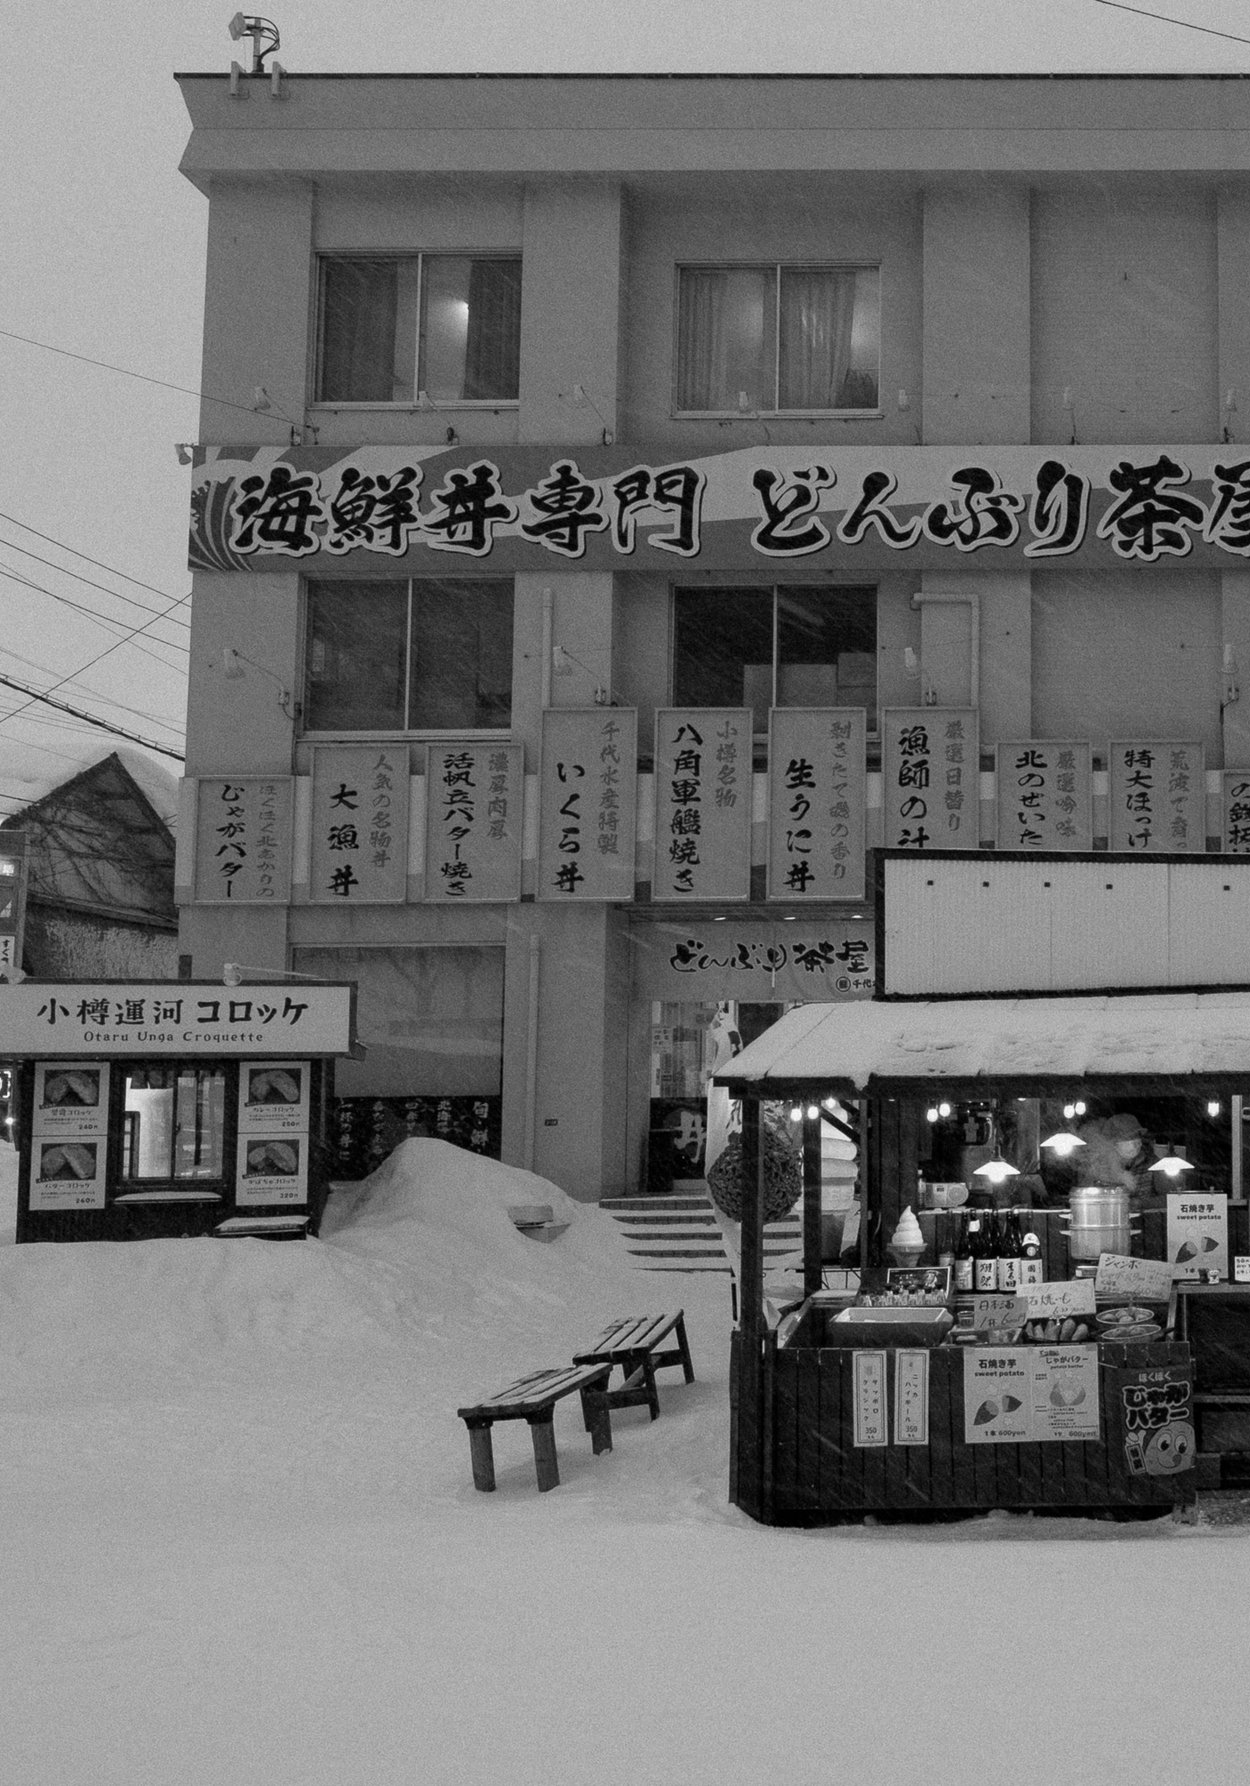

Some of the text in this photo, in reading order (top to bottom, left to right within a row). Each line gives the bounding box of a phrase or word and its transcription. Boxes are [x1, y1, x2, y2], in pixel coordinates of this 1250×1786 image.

[232, 463, 703, 555] 海鮮丼専門
[668, 722, 704, 893] 八角軍艦焼き
[714, 719, 739, 809] 小樽名物
[1014, 749, 1049, 846] 北のぜいた
[1123, 749, 1156, 849] 特大ほっけ
[214, 783, 248, 898] じゃがバター
[325, 783, 360, 898] 大漁丼
[369, 753, 394, 869] 人気の名物丼
[440, 751, 477, 897] 活帆立バター焼き
[551, 761, 586, 894] いくら丼
[782, 757, 817, 893] 生うに丼
[669, 939, 870, 974] どんぶり茶屋
[36, 996, 310, 1027] 小樽運河 コロッケ
[83, 1030, 264, 1045] Otaru Unga Croquette
[1180, 1203, 1215, 1213] 石焼き芋
[1104, 1255, 1143, 1270] ジャンボ
[974, 1370, 998, 1378] sweet
[998, 1370, 1026, 1378] potato
[978, 1358, 1018, 1370] 石焼き芋
[1045, 1355, 1090, 1365] じゃがバター
[1138, 1370, 1172, 1383] ほくほく
[1126, 1406, 1190, 1430] バター
